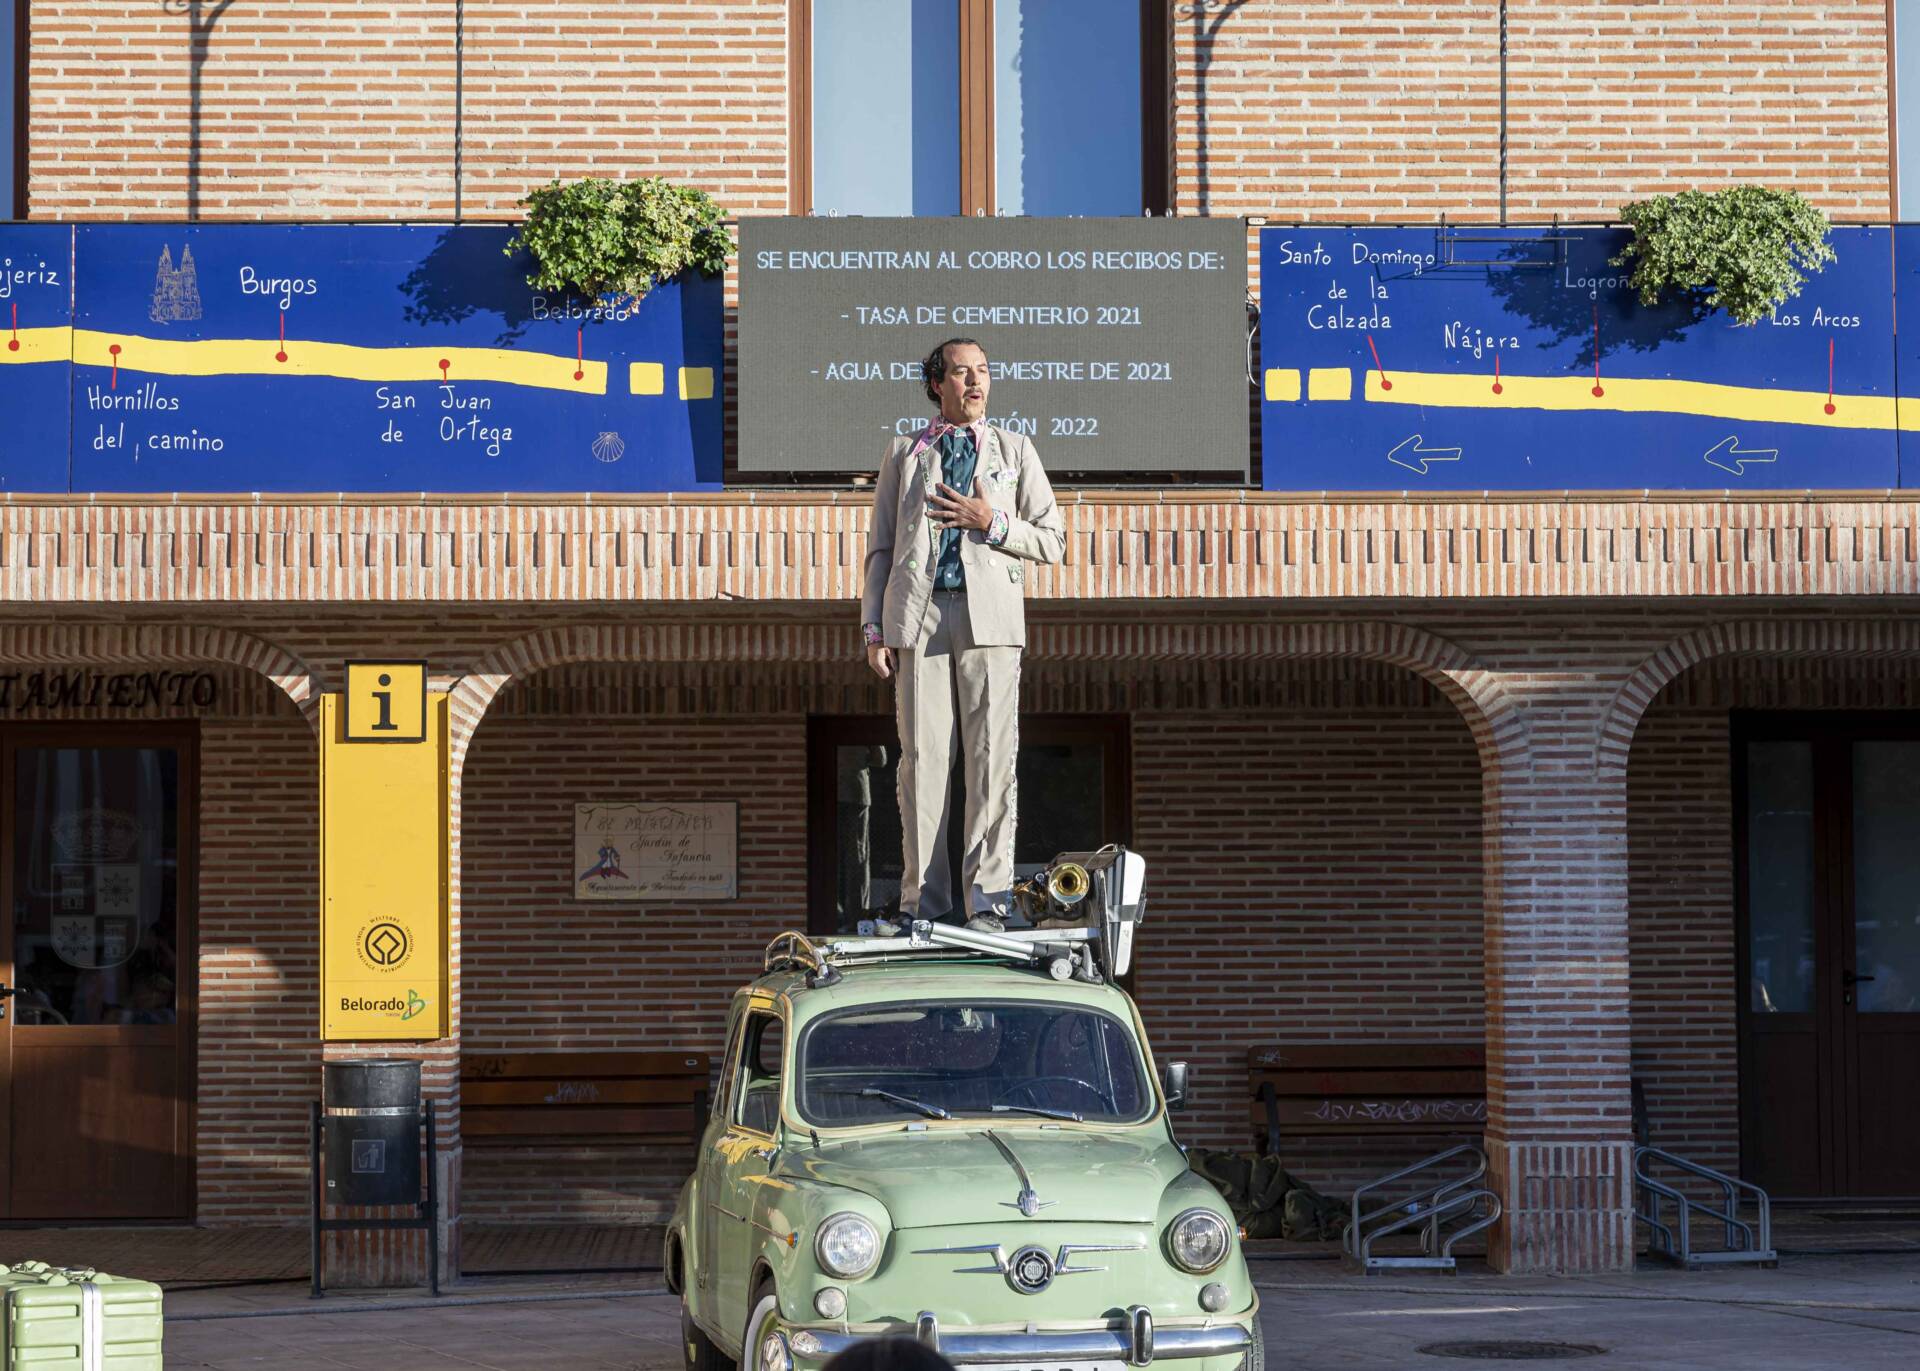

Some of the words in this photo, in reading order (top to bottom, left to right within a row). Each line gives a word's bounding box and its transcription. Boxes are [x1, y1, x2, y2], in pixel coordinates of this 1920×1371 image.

[757, 251, 782, 270] SE
[789, 251, 930, 270] ENCUENTRAN
[936, 251, 962, 270] AL
[968, 251, 1041, 270] COBRO
[1047, 251, 1086, 270] LOS
[1092, 251, 1182, 270] RECIBOS
[1188, 251, 1224, 270] DE:
[1280, 240, 1331, 265] Santo
[1352, 242, 1435, 275] Domingo
[0, 257, 60, 298] jeriz
[240, 266, 317, 310] Burgos
[1327, 279, 1348, 299] de
[1370, 275, 1389, 299] la
[1565, 267, 1636, 300] Logroñ
[532, 296, 630, 321] Belorado
[855, 306, 910, 325] TASA
[916, 306, 946, 325] DE
[952, 306, 1089, 325] CEMENTERIO
[1096, 306, 1142, 325] 2021
[1307, 303, 1392, 330] Calzada
[1773, 307, 1801, 327] Los
[1812, 306, 1861, 328] Arcos
[1444, 321, 1520, 359] Nájera
[825, 362, 884, 380] AGUA
[988, 362, 1084, 380] EMESTRE
[1090, 362, 1119, 380] DE
[1127, 362, 1173, 380] 2021
[88, 382, 179, 410] Hornillos
[376, 386, 416, 409] San
[439, 385, 491, 410] Juan
[93, 422, 124, 450] del
[149, 429, 224, 451] camino
[381, 420, 404, 443] de
[440, 415, 513, 457] Ortega
[1051, 417, 1099, 436] 2022
[341, 997, 405, 1011] Belorado
[1027, 1265, 1040, 1276] 600
